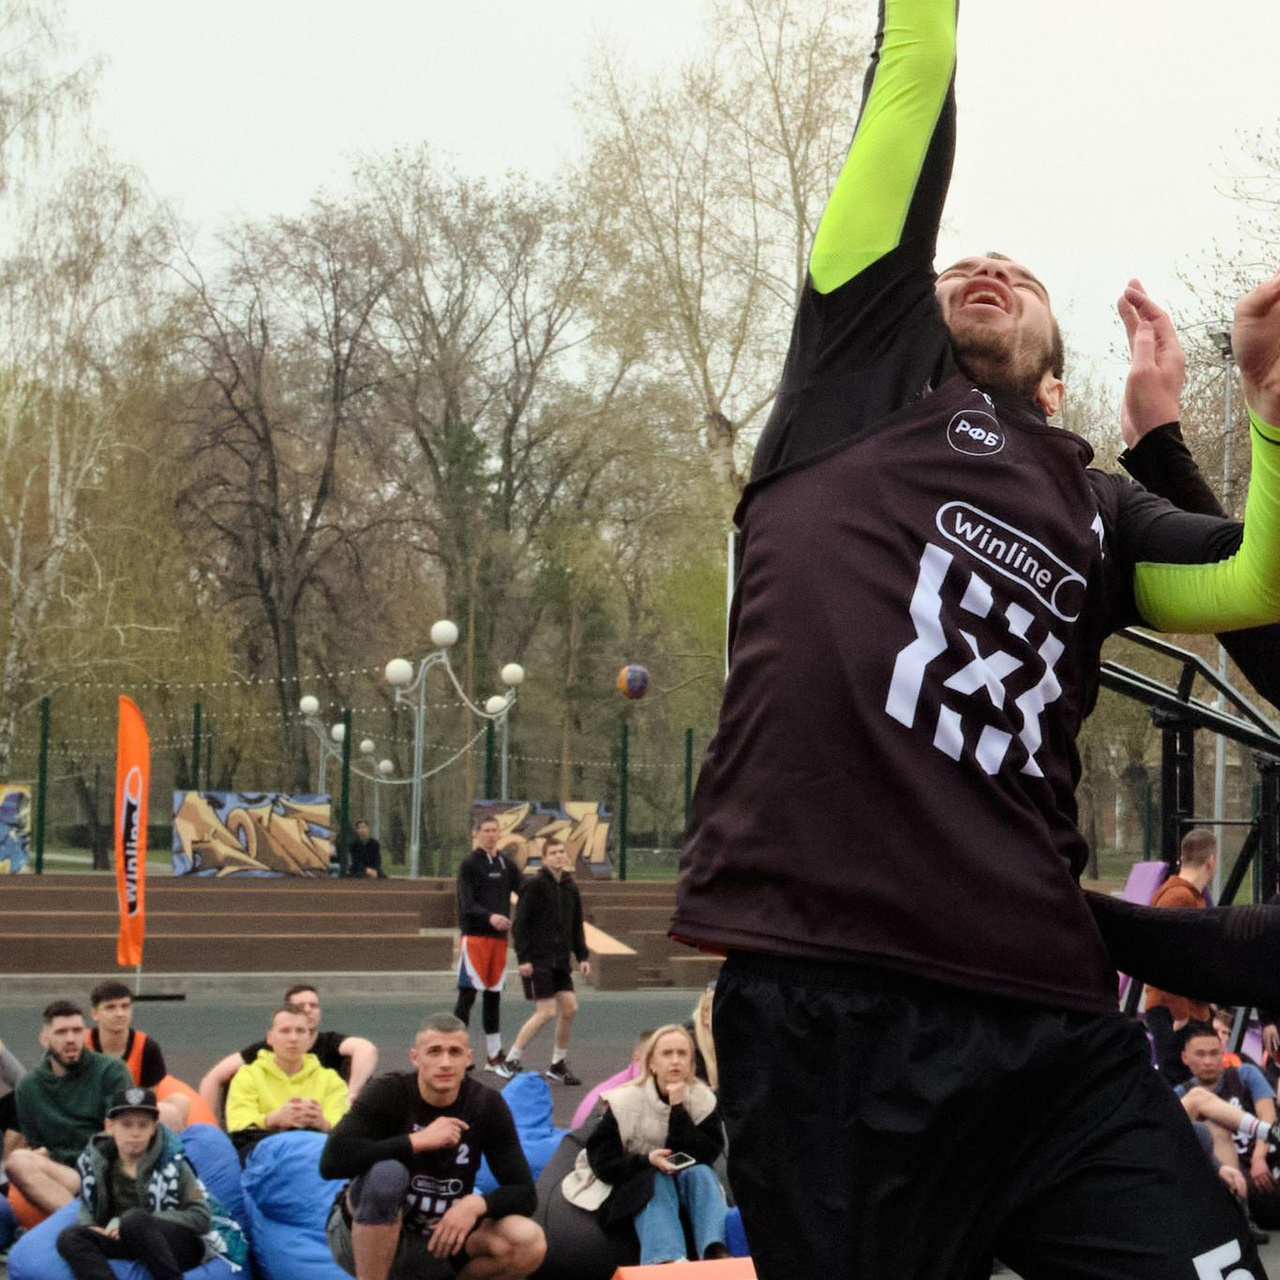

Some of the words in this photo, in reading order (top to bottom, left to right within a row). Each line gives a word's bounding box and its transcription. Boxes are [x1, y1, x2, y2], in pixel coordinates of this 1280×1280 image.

[955, 419, 999, 446] РФБ
[955, 512, 1052, 588] Winline
[456, 1143, 469, 1164] 2
